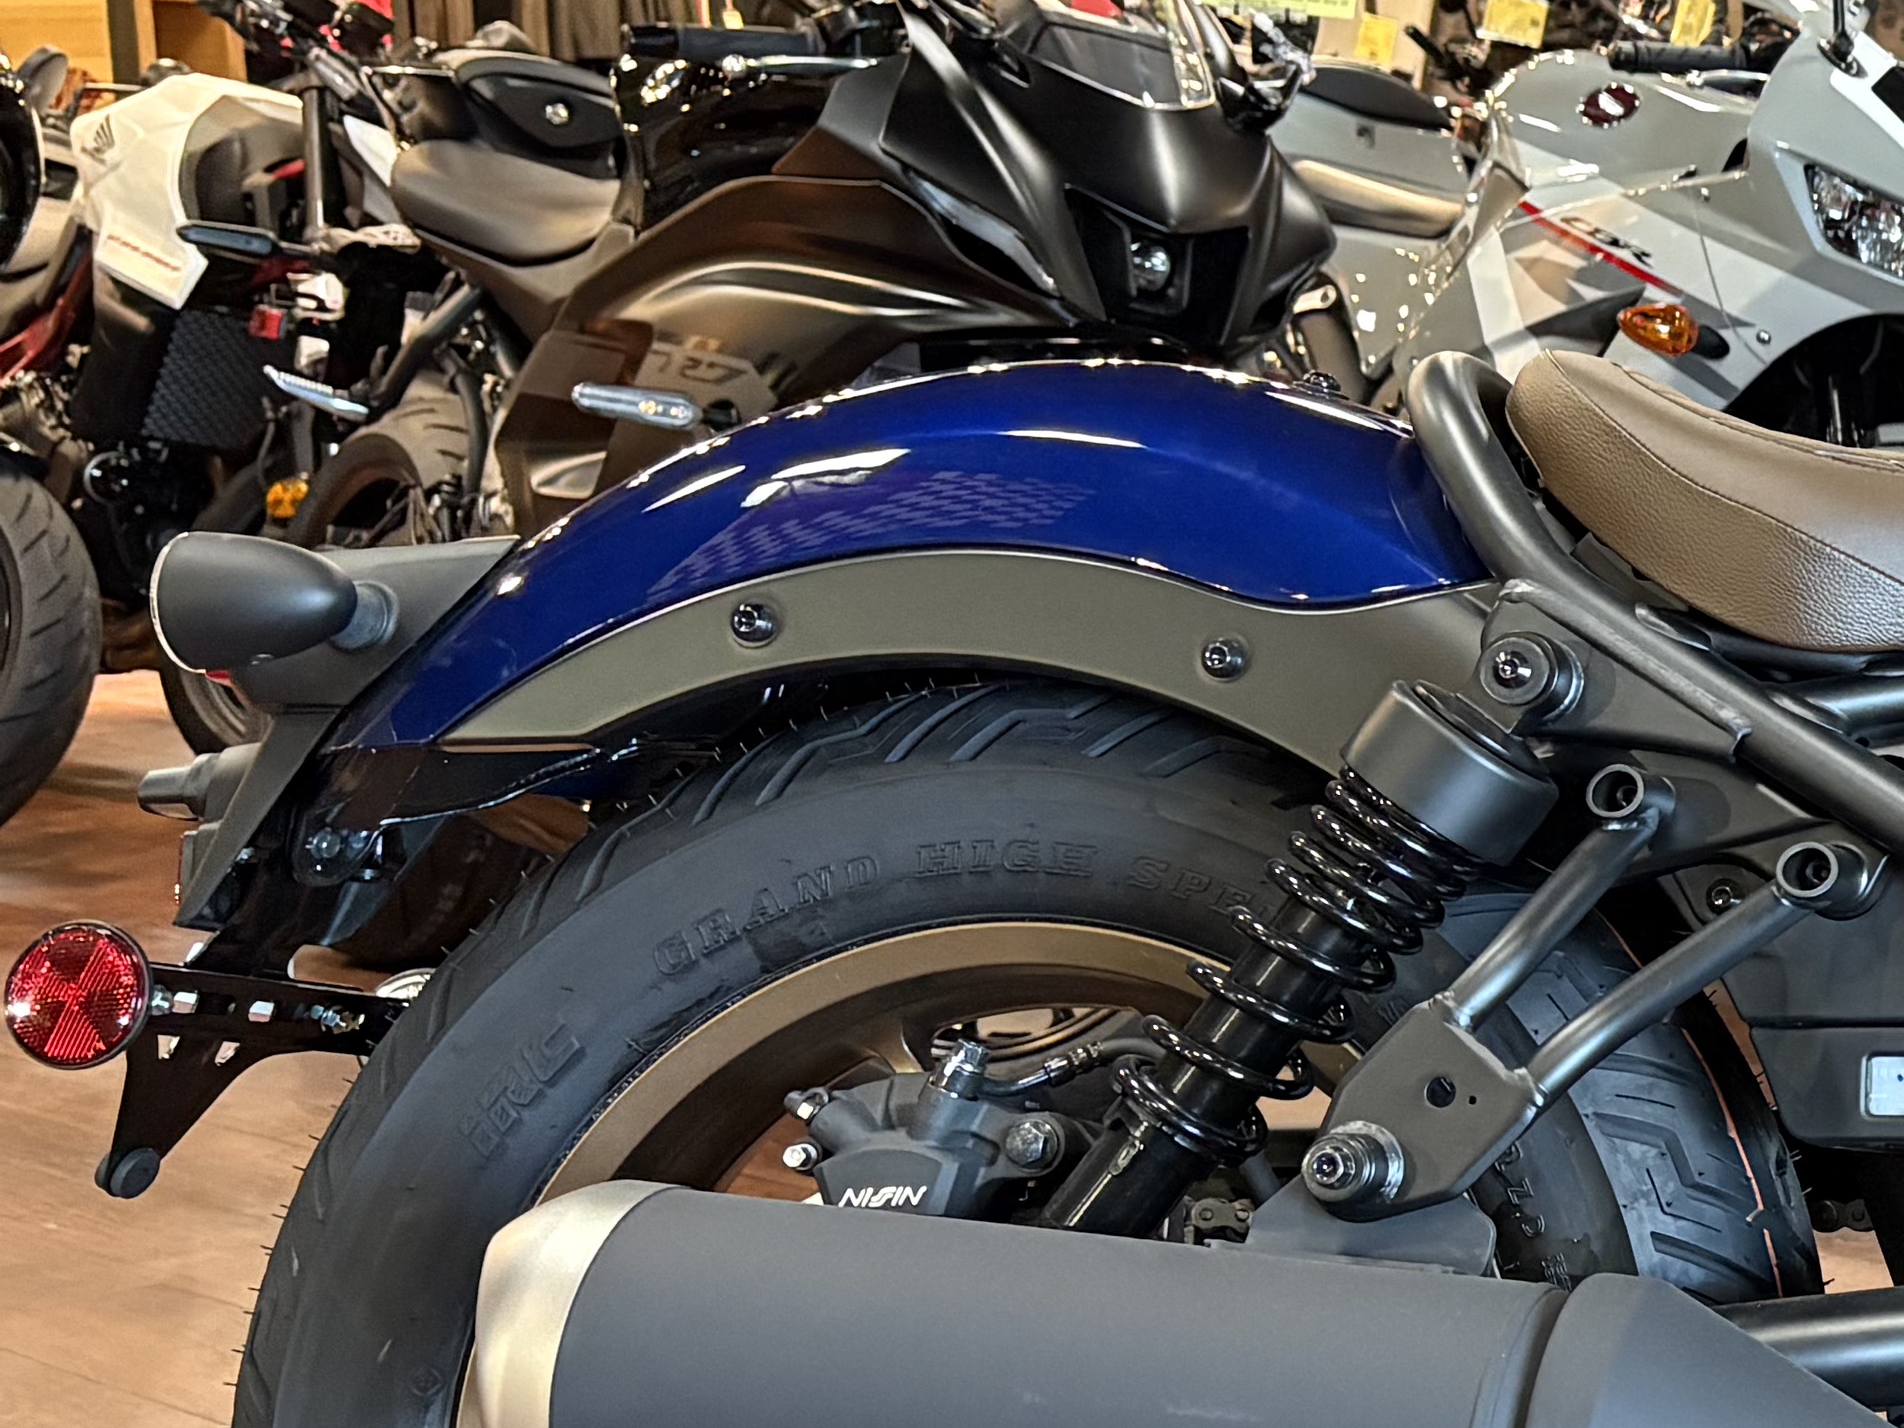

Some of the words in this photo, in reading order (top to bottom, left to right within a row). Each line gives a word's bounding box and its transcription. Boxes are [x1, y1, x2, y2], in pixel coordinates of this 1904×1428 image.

[1559, 216, 1653, 268] CBR
[653, 854, 881, 975] GRAND
[915, 839, 1098, 877] HIGH
[1128, 855, 1273, 917] SPE
[838, 1185, 927, 1208] NISSIN
